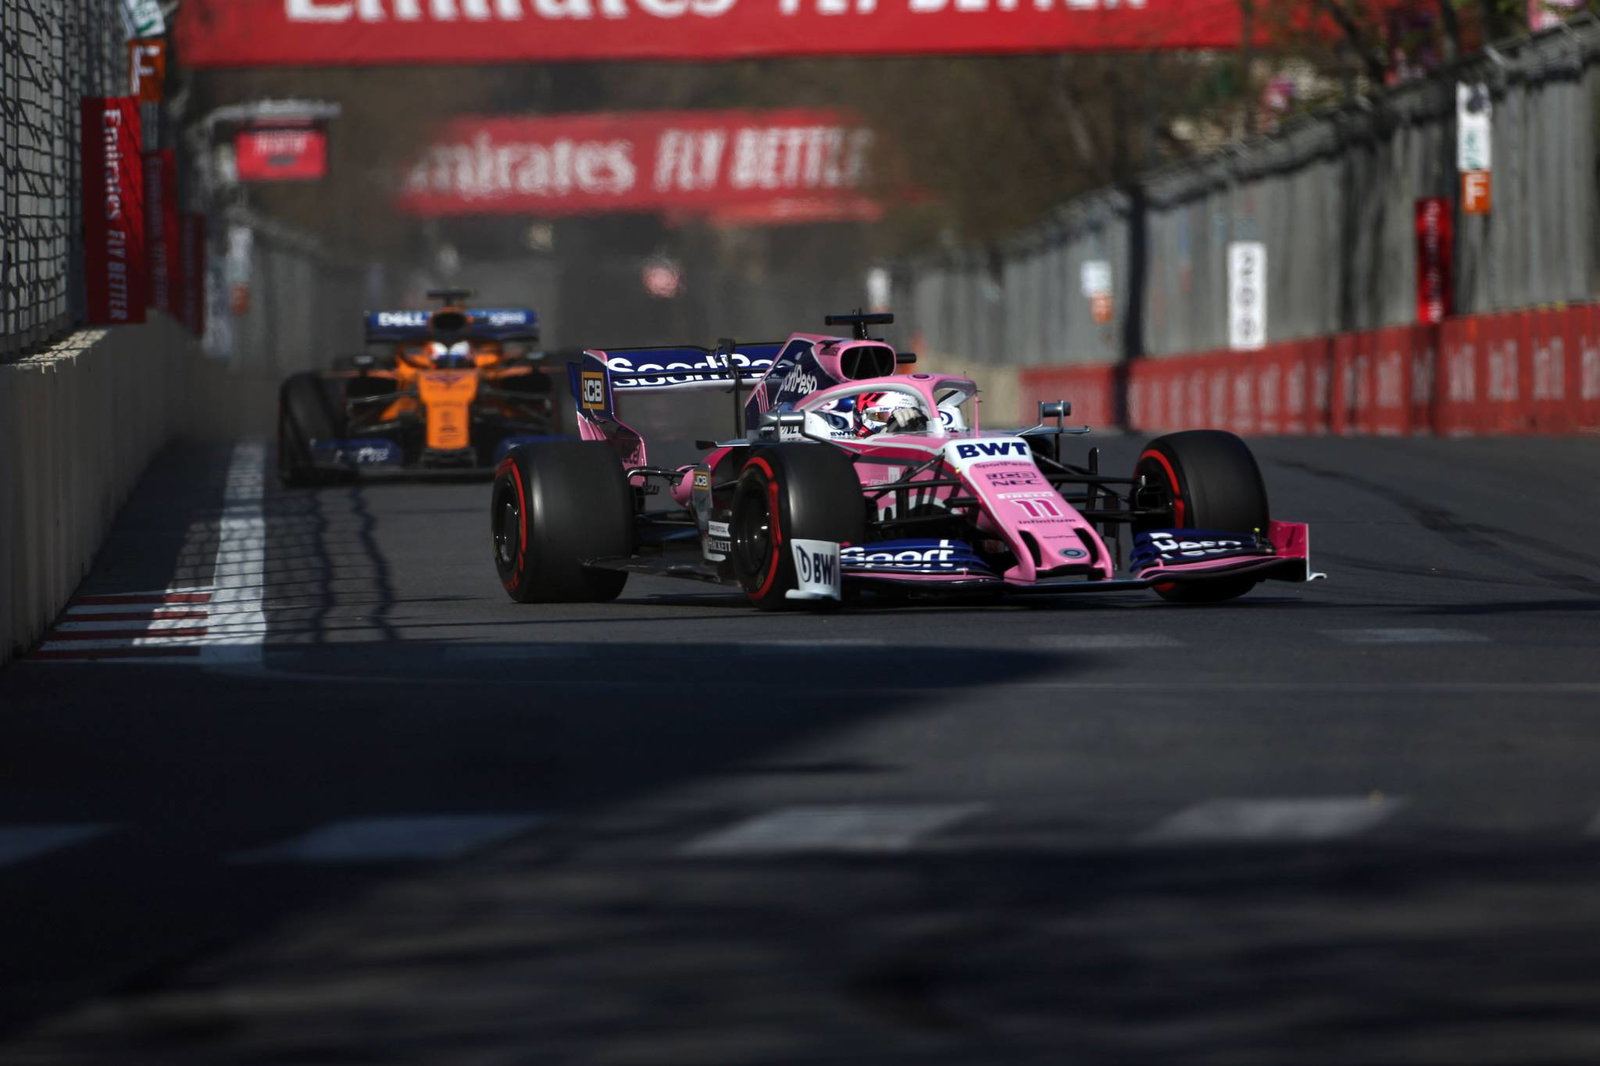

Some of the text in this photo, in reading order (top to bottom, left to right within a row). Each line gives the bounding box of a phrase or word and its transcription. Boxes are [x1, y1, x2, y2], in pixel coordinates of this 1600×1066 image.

[132, 45, 161, 96] F
[404, 132, 637, 199] mirates
[1464, 174, 1487, 210] F
[103, 109, 128, 321] Emirates FLY BETTER
[956, 442, 1027, 459] BWT
[1009, 498, 1063, 519] 11
